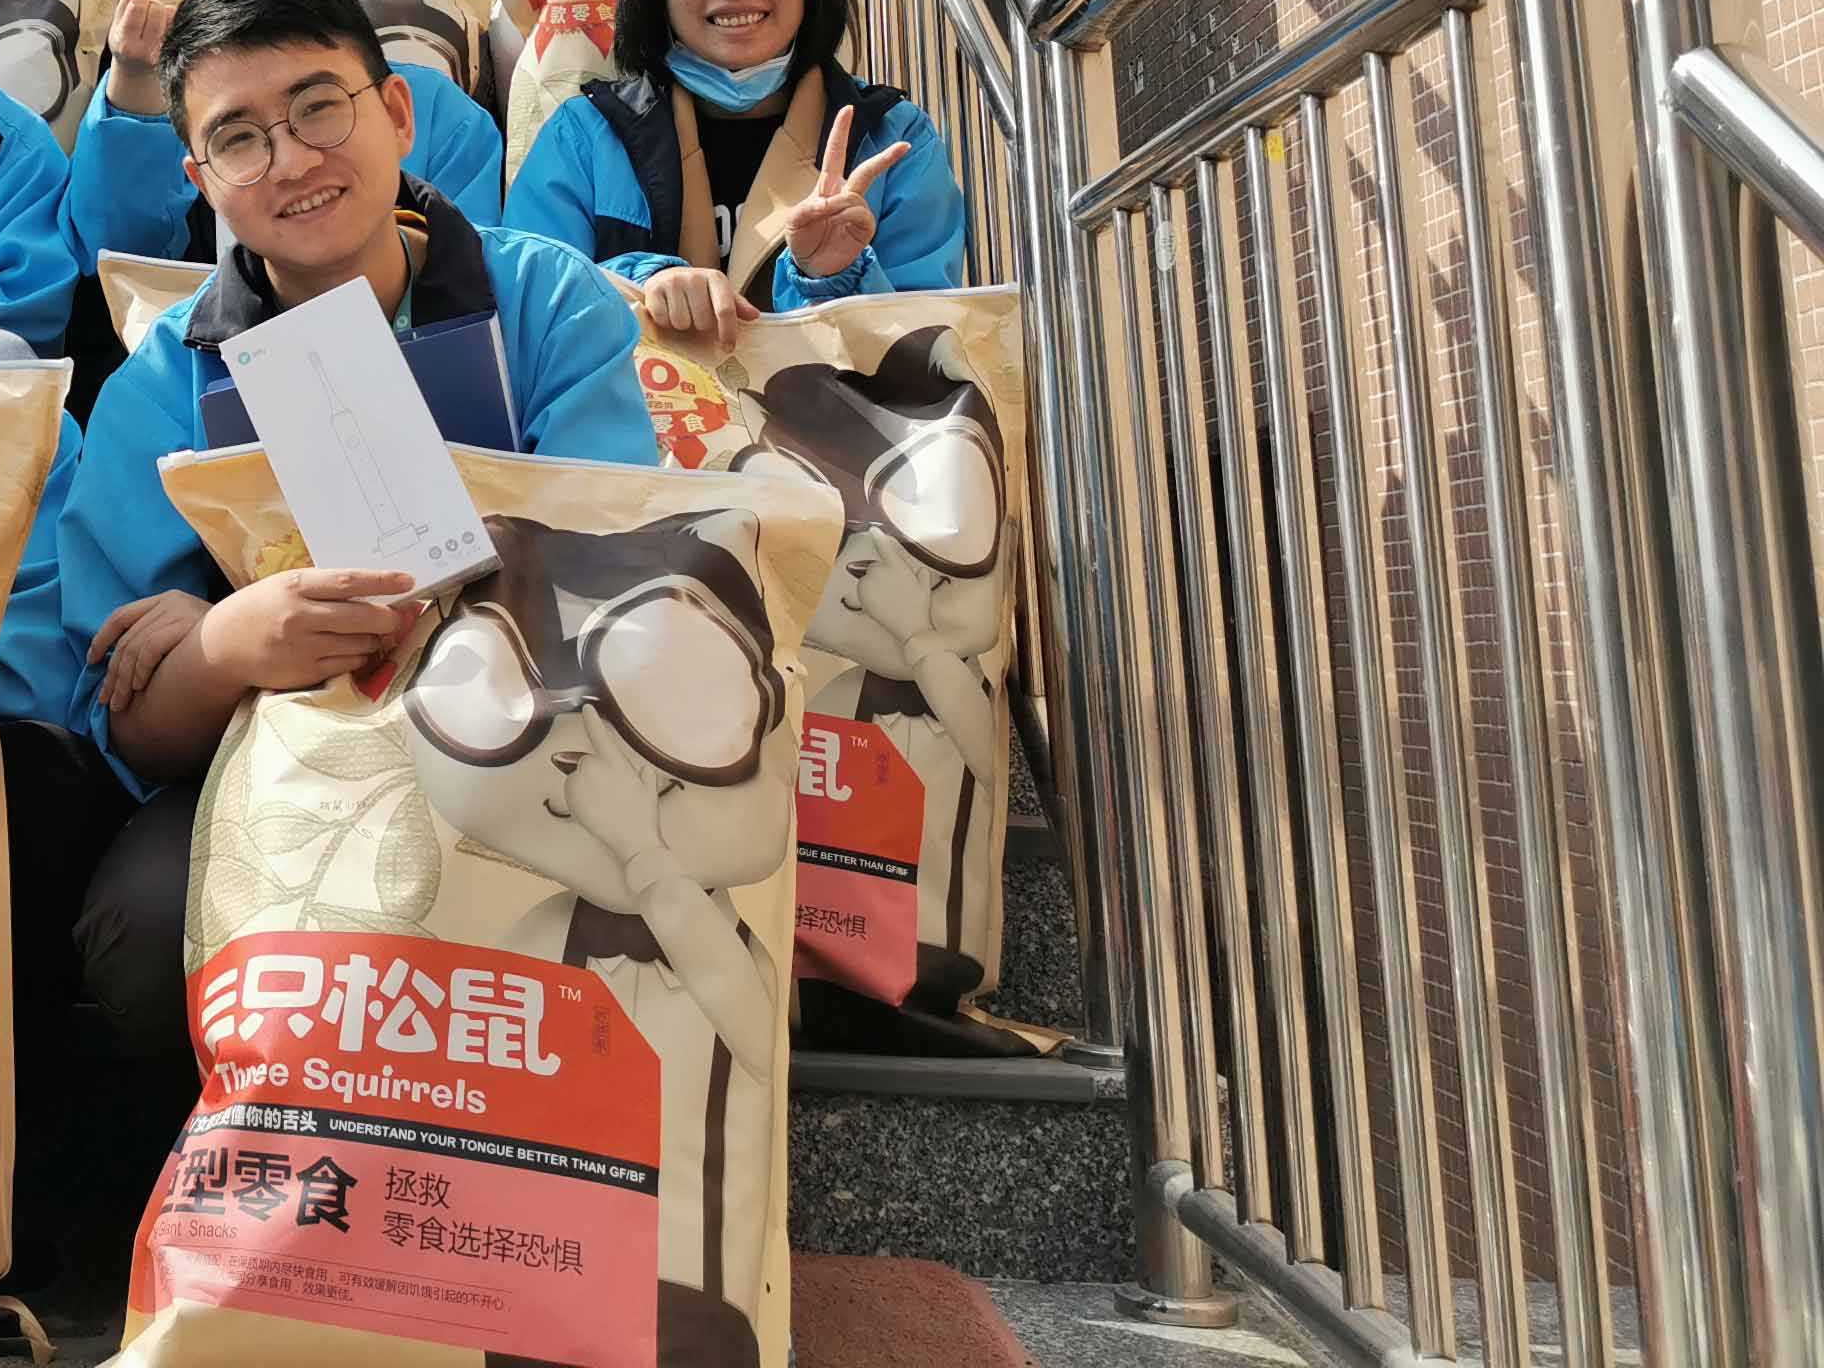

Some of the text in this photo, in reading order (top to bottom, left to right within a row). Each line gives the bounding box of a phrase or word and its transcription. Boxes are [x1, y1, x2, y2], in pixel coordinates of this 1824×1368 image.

[214, 1056, 488, 1114] Three Squirrels
[329, 1118, 647, 1185] UNDERSTAND YOUR TONGUE BETTER THAN GF/BF
[383, 1164, 452, 1210] 拯救
[188, 1220, 239, 1239] Snacks
[380, 1208, 584, 1277] 零食选择恐惧
